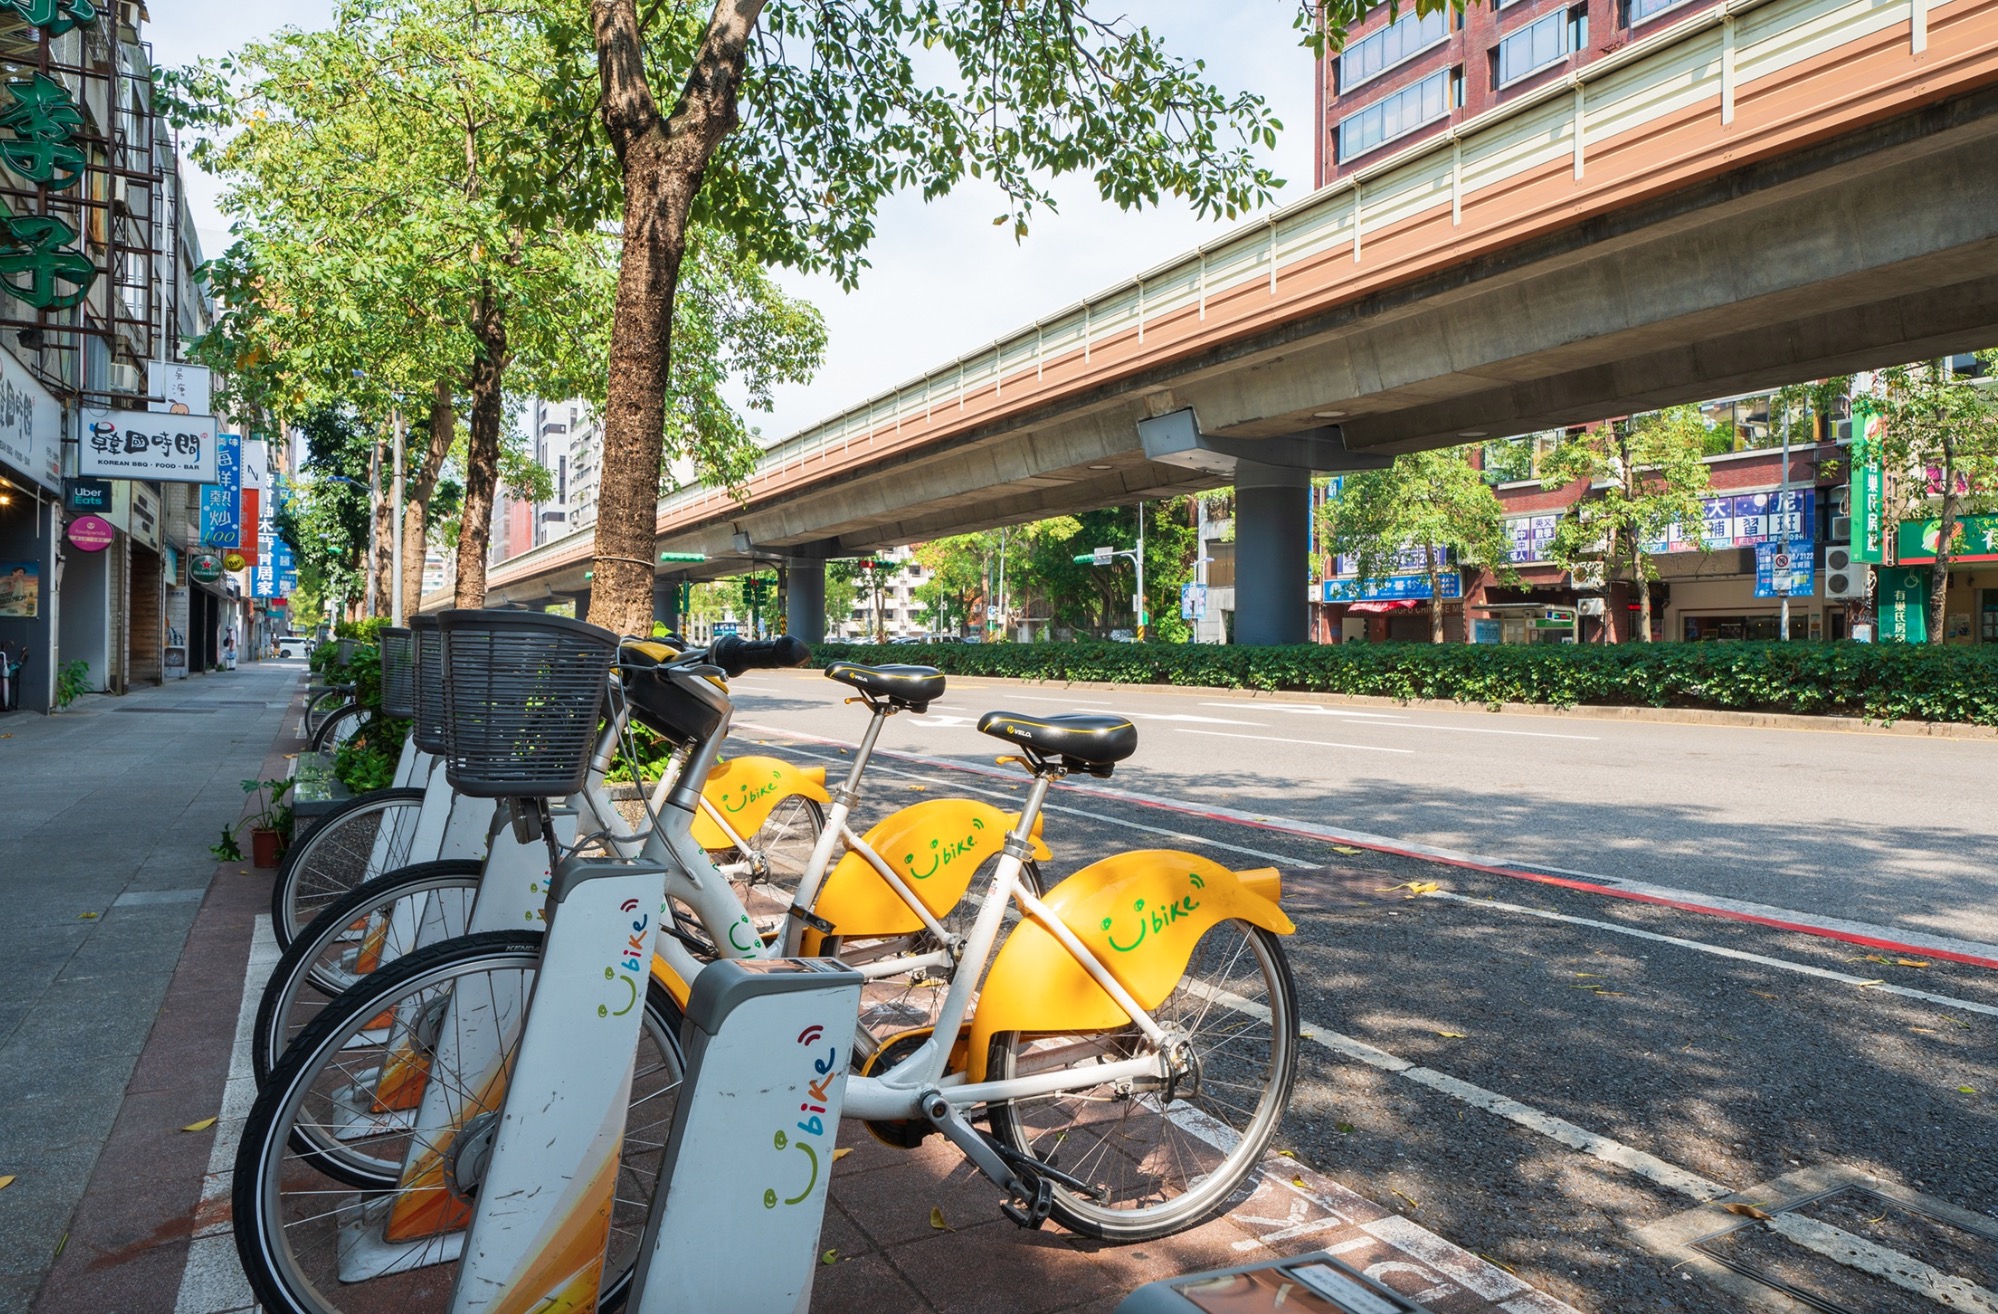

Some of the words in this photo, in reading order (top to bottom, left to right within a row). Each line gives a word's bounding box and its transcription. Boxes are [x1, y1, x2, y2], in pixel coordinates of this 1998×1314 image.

[89, 421, 200, 463] 韓國時間
[97, 459, 130, 467] KOREAN
[74, 487, 102, 497] Uber
[74, 496, 102, 505] Eats
[75, 528, 106, 536] foodpanda
[204, 531, 236, 543] 100
[1738, 536, 1764, 546] IELTS
[228, 559, 240, 567] Bar
